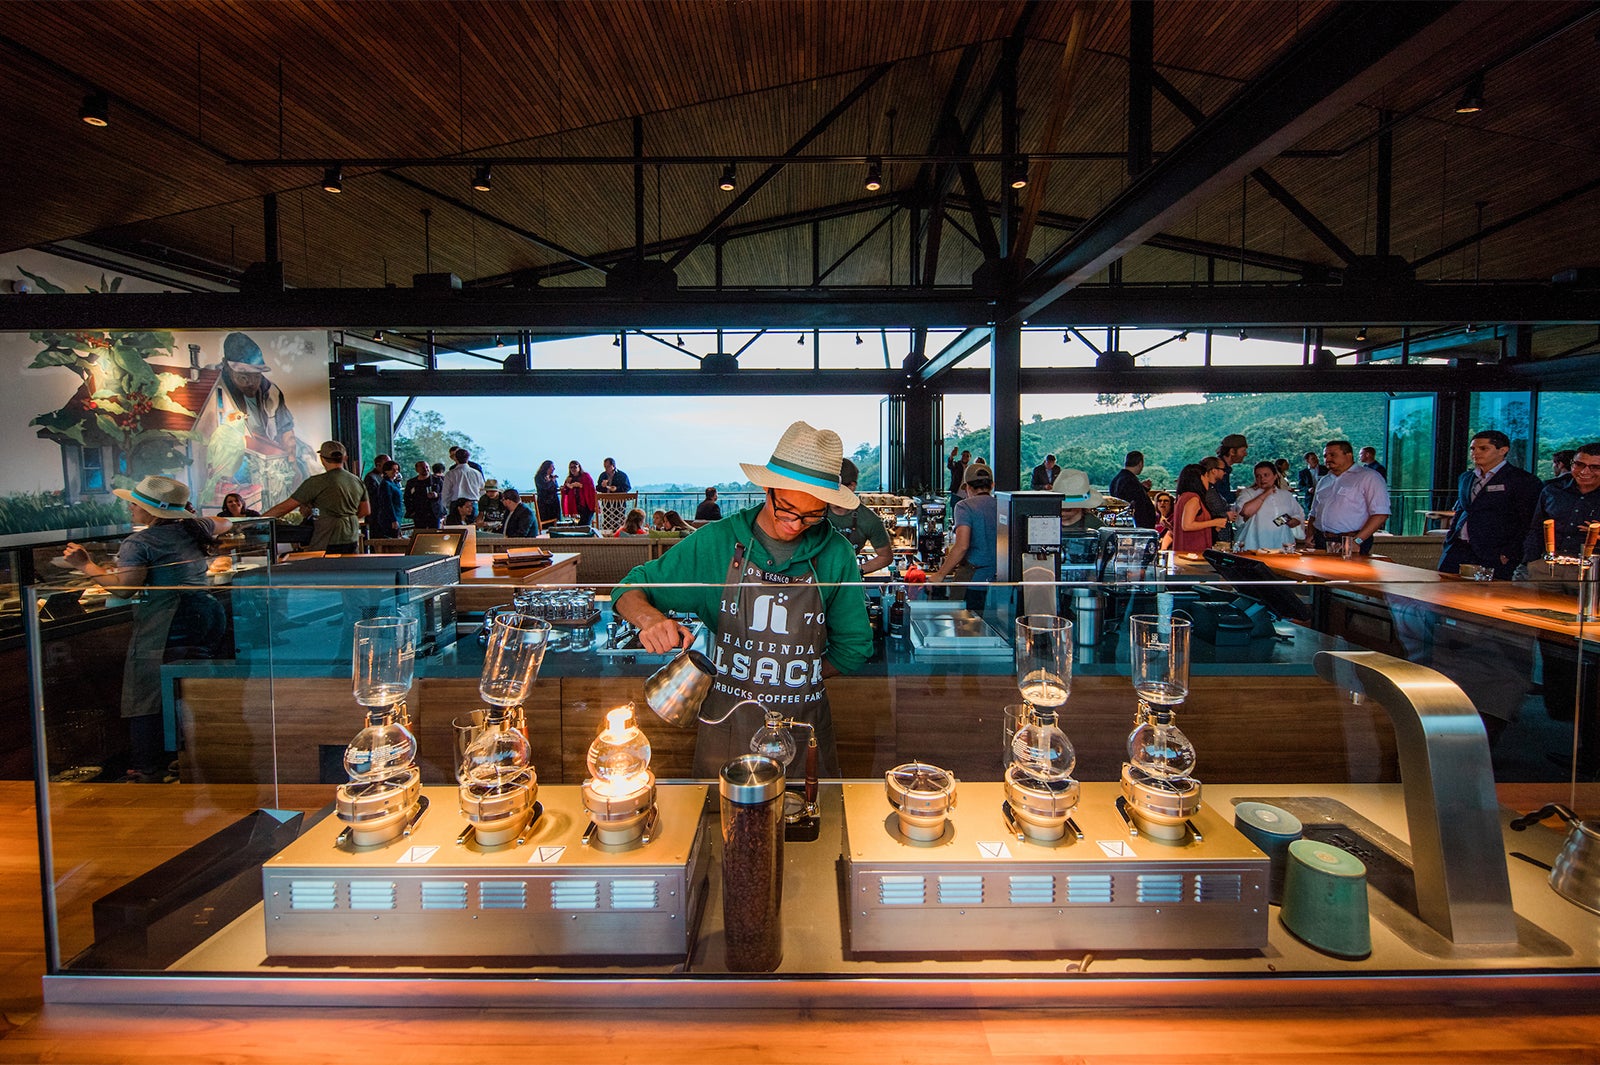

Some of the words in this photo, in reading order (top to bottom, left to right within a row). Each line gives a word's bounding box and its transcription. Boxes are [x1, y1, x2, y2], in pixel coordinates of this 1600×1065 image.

[720, 599, 738, 615] 19
[804, 612, 825, 625] 70
[723, 632, 815, 655] HACIENDA
[713, 681, 753, 700] RBUCKS
[757, 693, 800, 703] COFFEE
[804, 687, 825, 703] FAR
